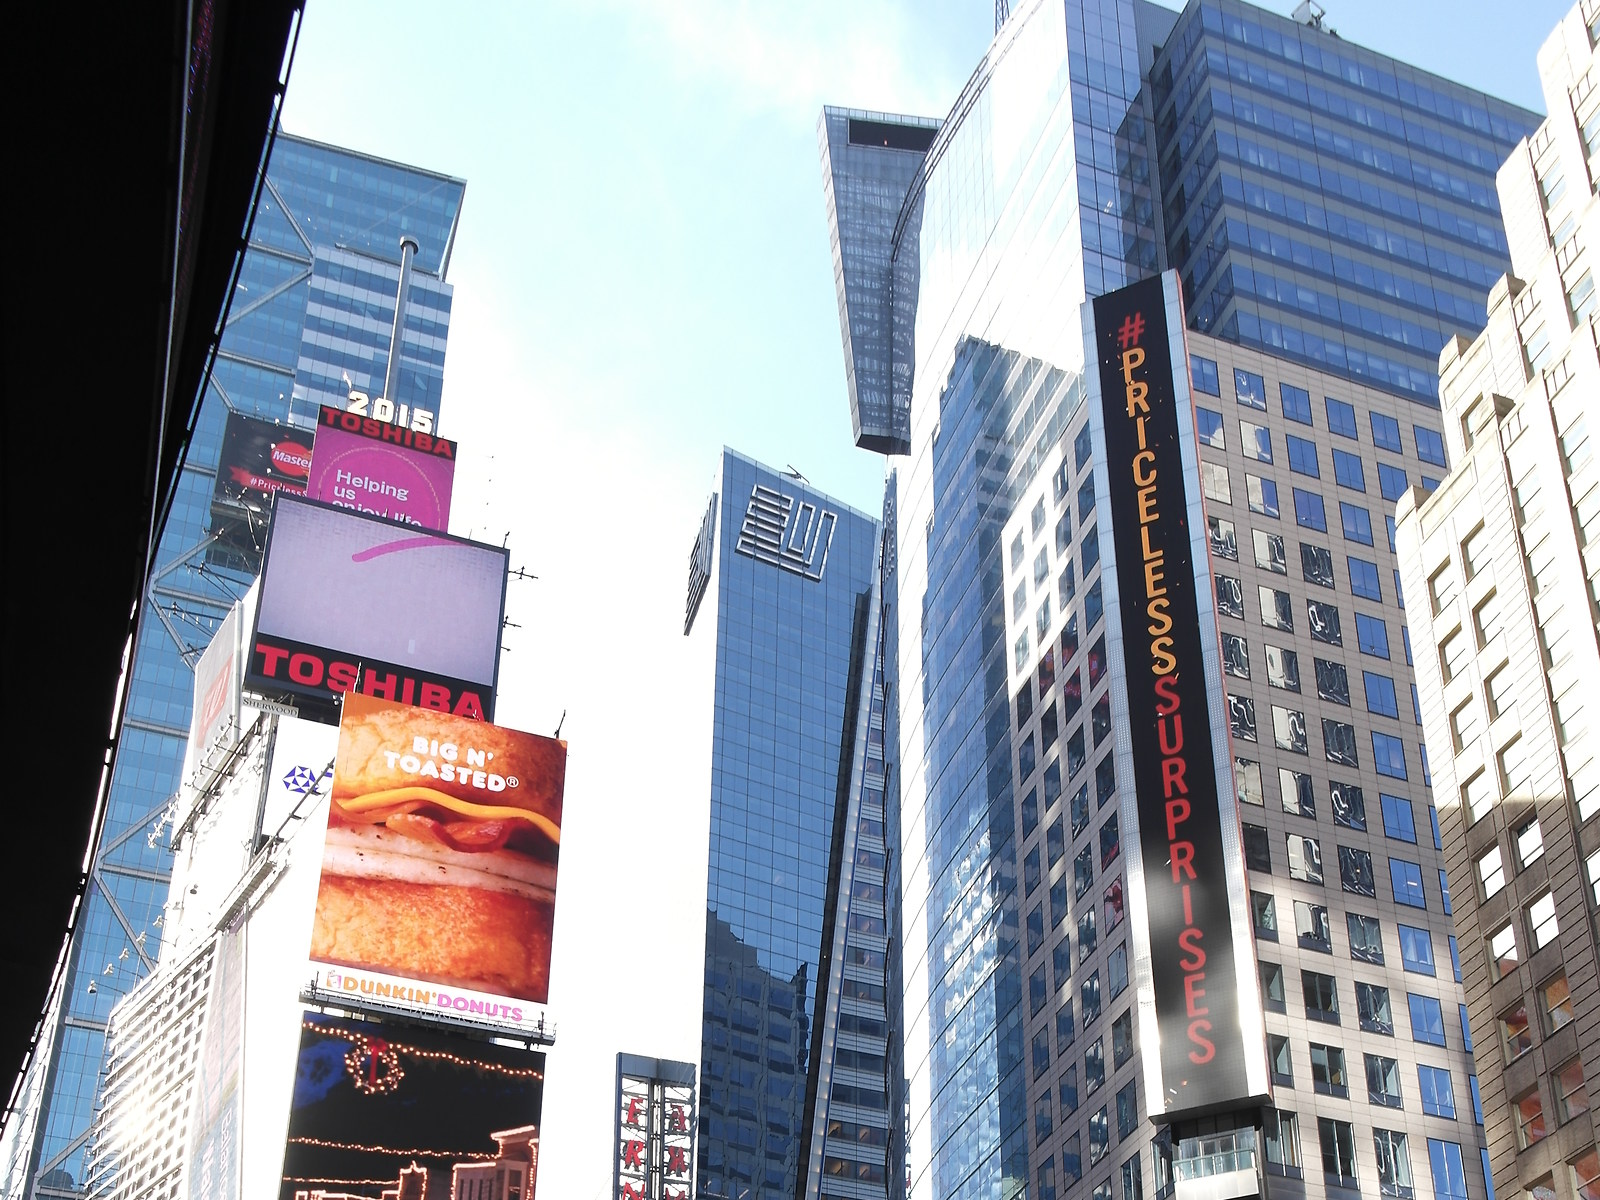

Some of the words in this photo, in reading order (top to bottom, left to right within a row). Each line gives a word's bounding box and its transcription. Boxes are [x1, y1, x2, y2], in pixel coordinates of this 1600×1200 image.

[348, 390, 434, 435] 2015
[322, 407, 453, 458] TOSHIBA
[333, 487, 356, 500] us
[336, 469, 409, 502] Helping
[255, 643, 485, 721] TOSHIBA
[244, 699, 298, 716] SHERWOOD
[413, 736, 457, 761] BIG
[467, 748, 494, 768] N'
[437, 993, 523, 1022] DONUTS
